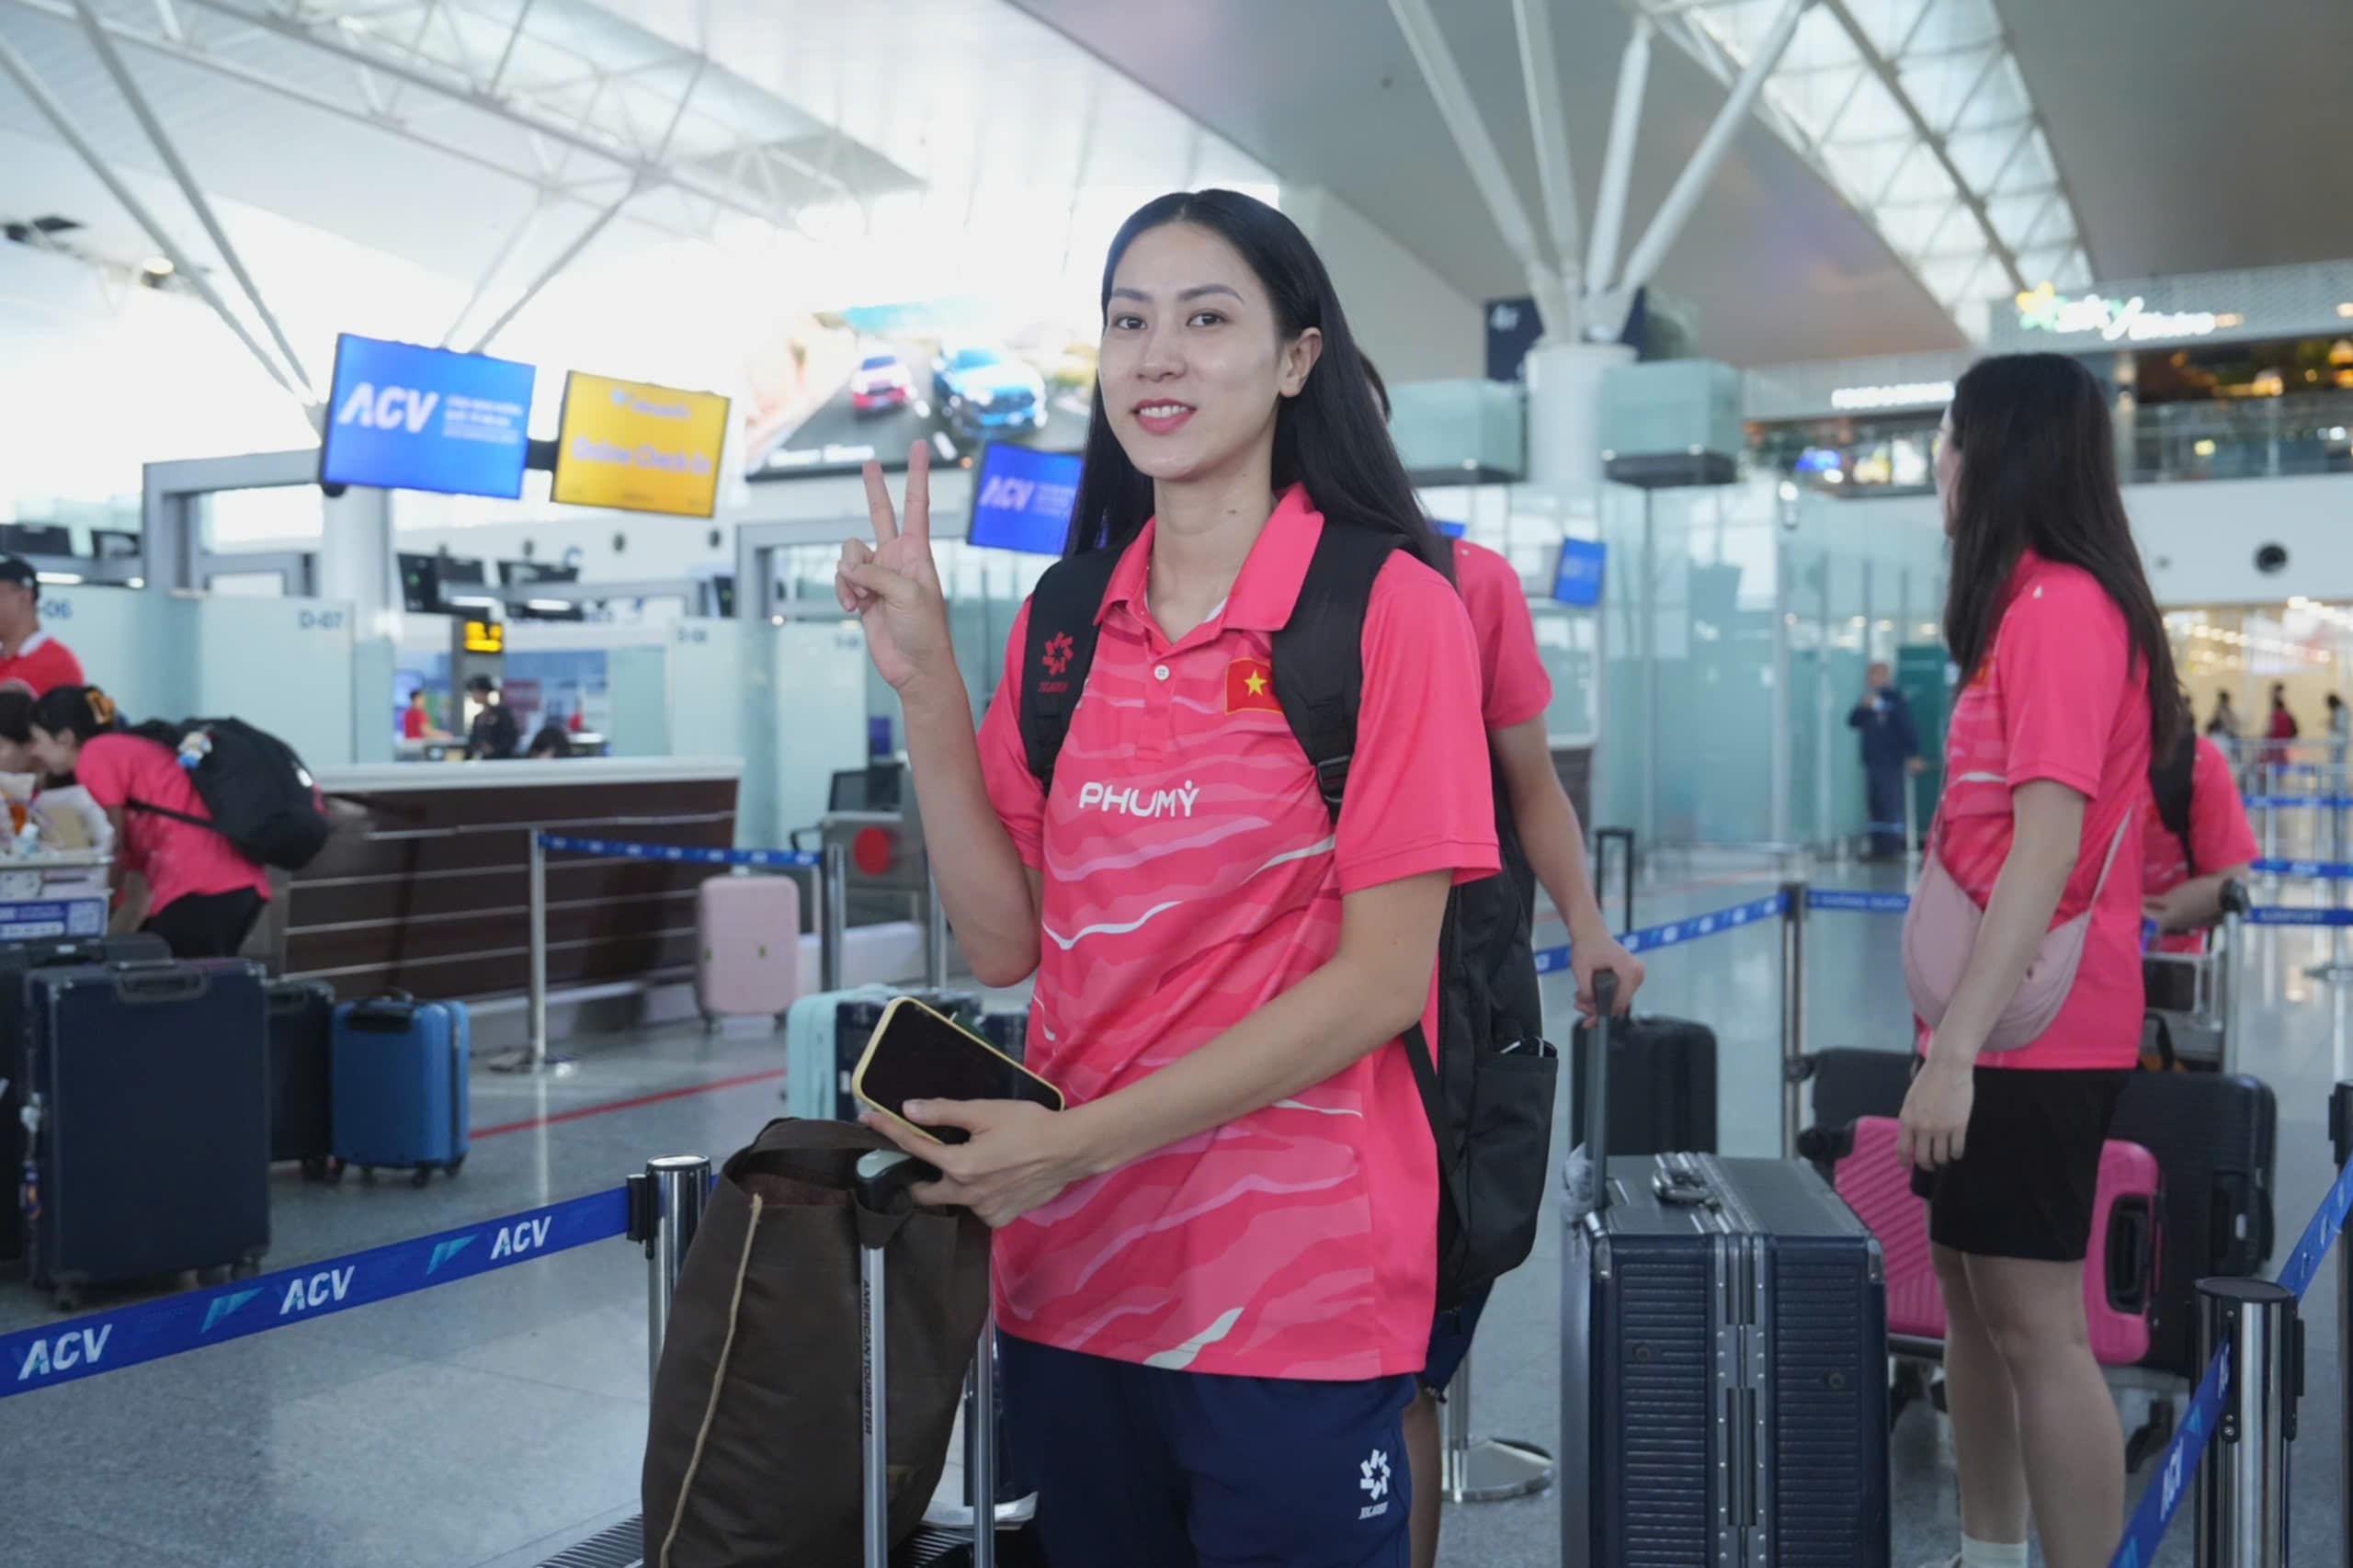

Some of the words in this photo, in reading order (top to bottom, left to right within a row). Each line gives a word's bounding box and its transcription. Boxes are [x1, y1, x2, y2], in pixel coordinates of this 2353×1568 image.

[337, 381, 439, 434] ACV
[978, 474, 1036, 513] ACV
[490, 1216, 551, 1260] ACV
[279, 1266, 355, 1315] ACV
[862, 1280, 872, 1356] AMERICAN
[17, 1324, 113, 1381] ACV
[863, 1359, 873, 1435] TOURISTER
